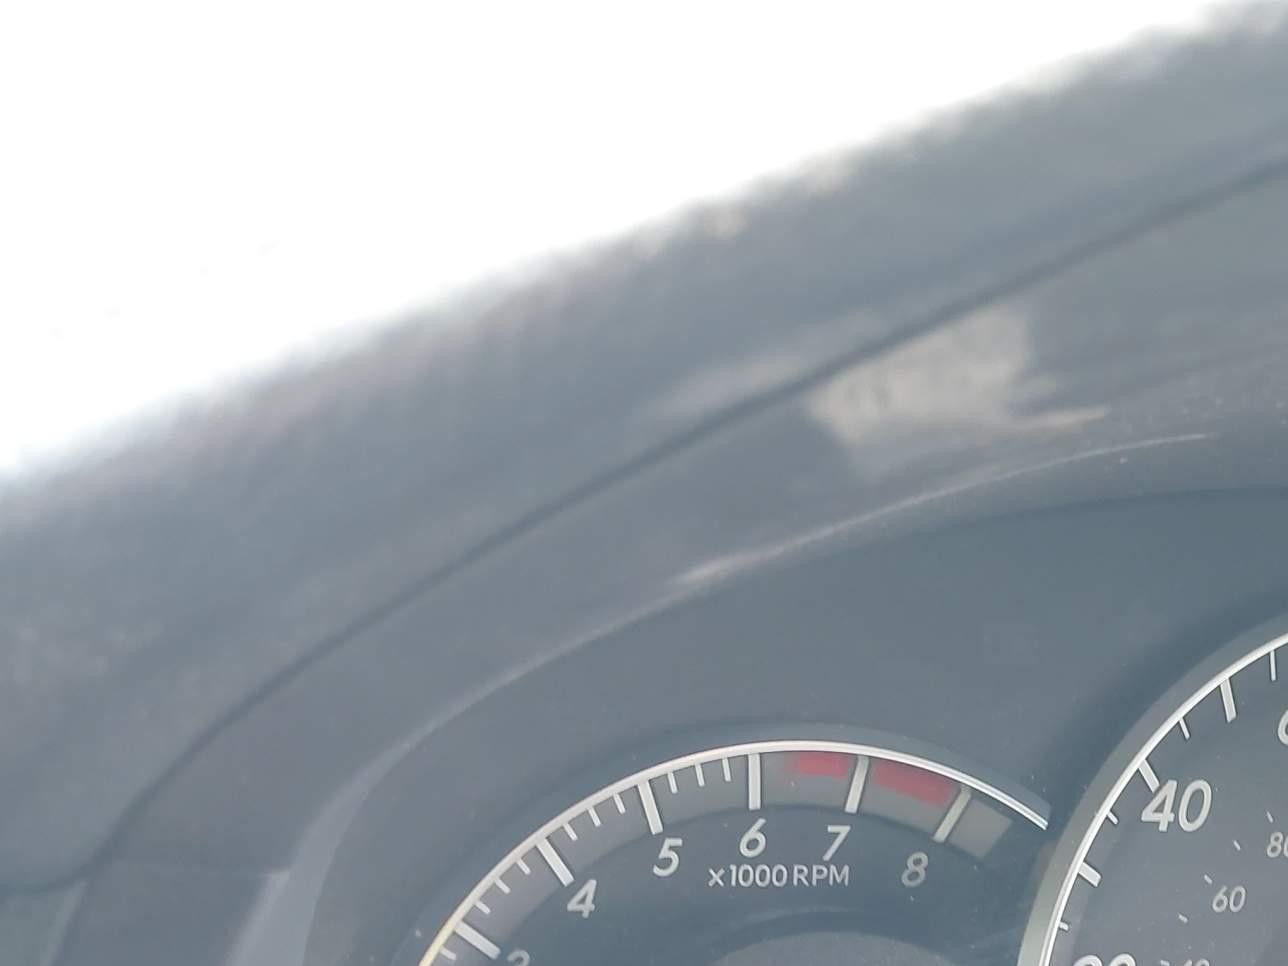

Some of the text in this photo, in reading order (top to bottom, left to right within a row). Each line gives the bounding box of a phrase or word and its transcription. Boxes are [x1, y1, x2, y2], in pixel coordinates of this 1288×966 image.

[1141, 780, 1212, 832] 40
[738, 818, 766, 857] 6
[825, 826, 852, 860] 7
[652, 837, 682, 877] 5
[792, 864, 851, 887] RPM
[901, 852, 929, 888] 8
[566, 880, 597, 918] 4
[1212, 885, 1247, 912] 60
